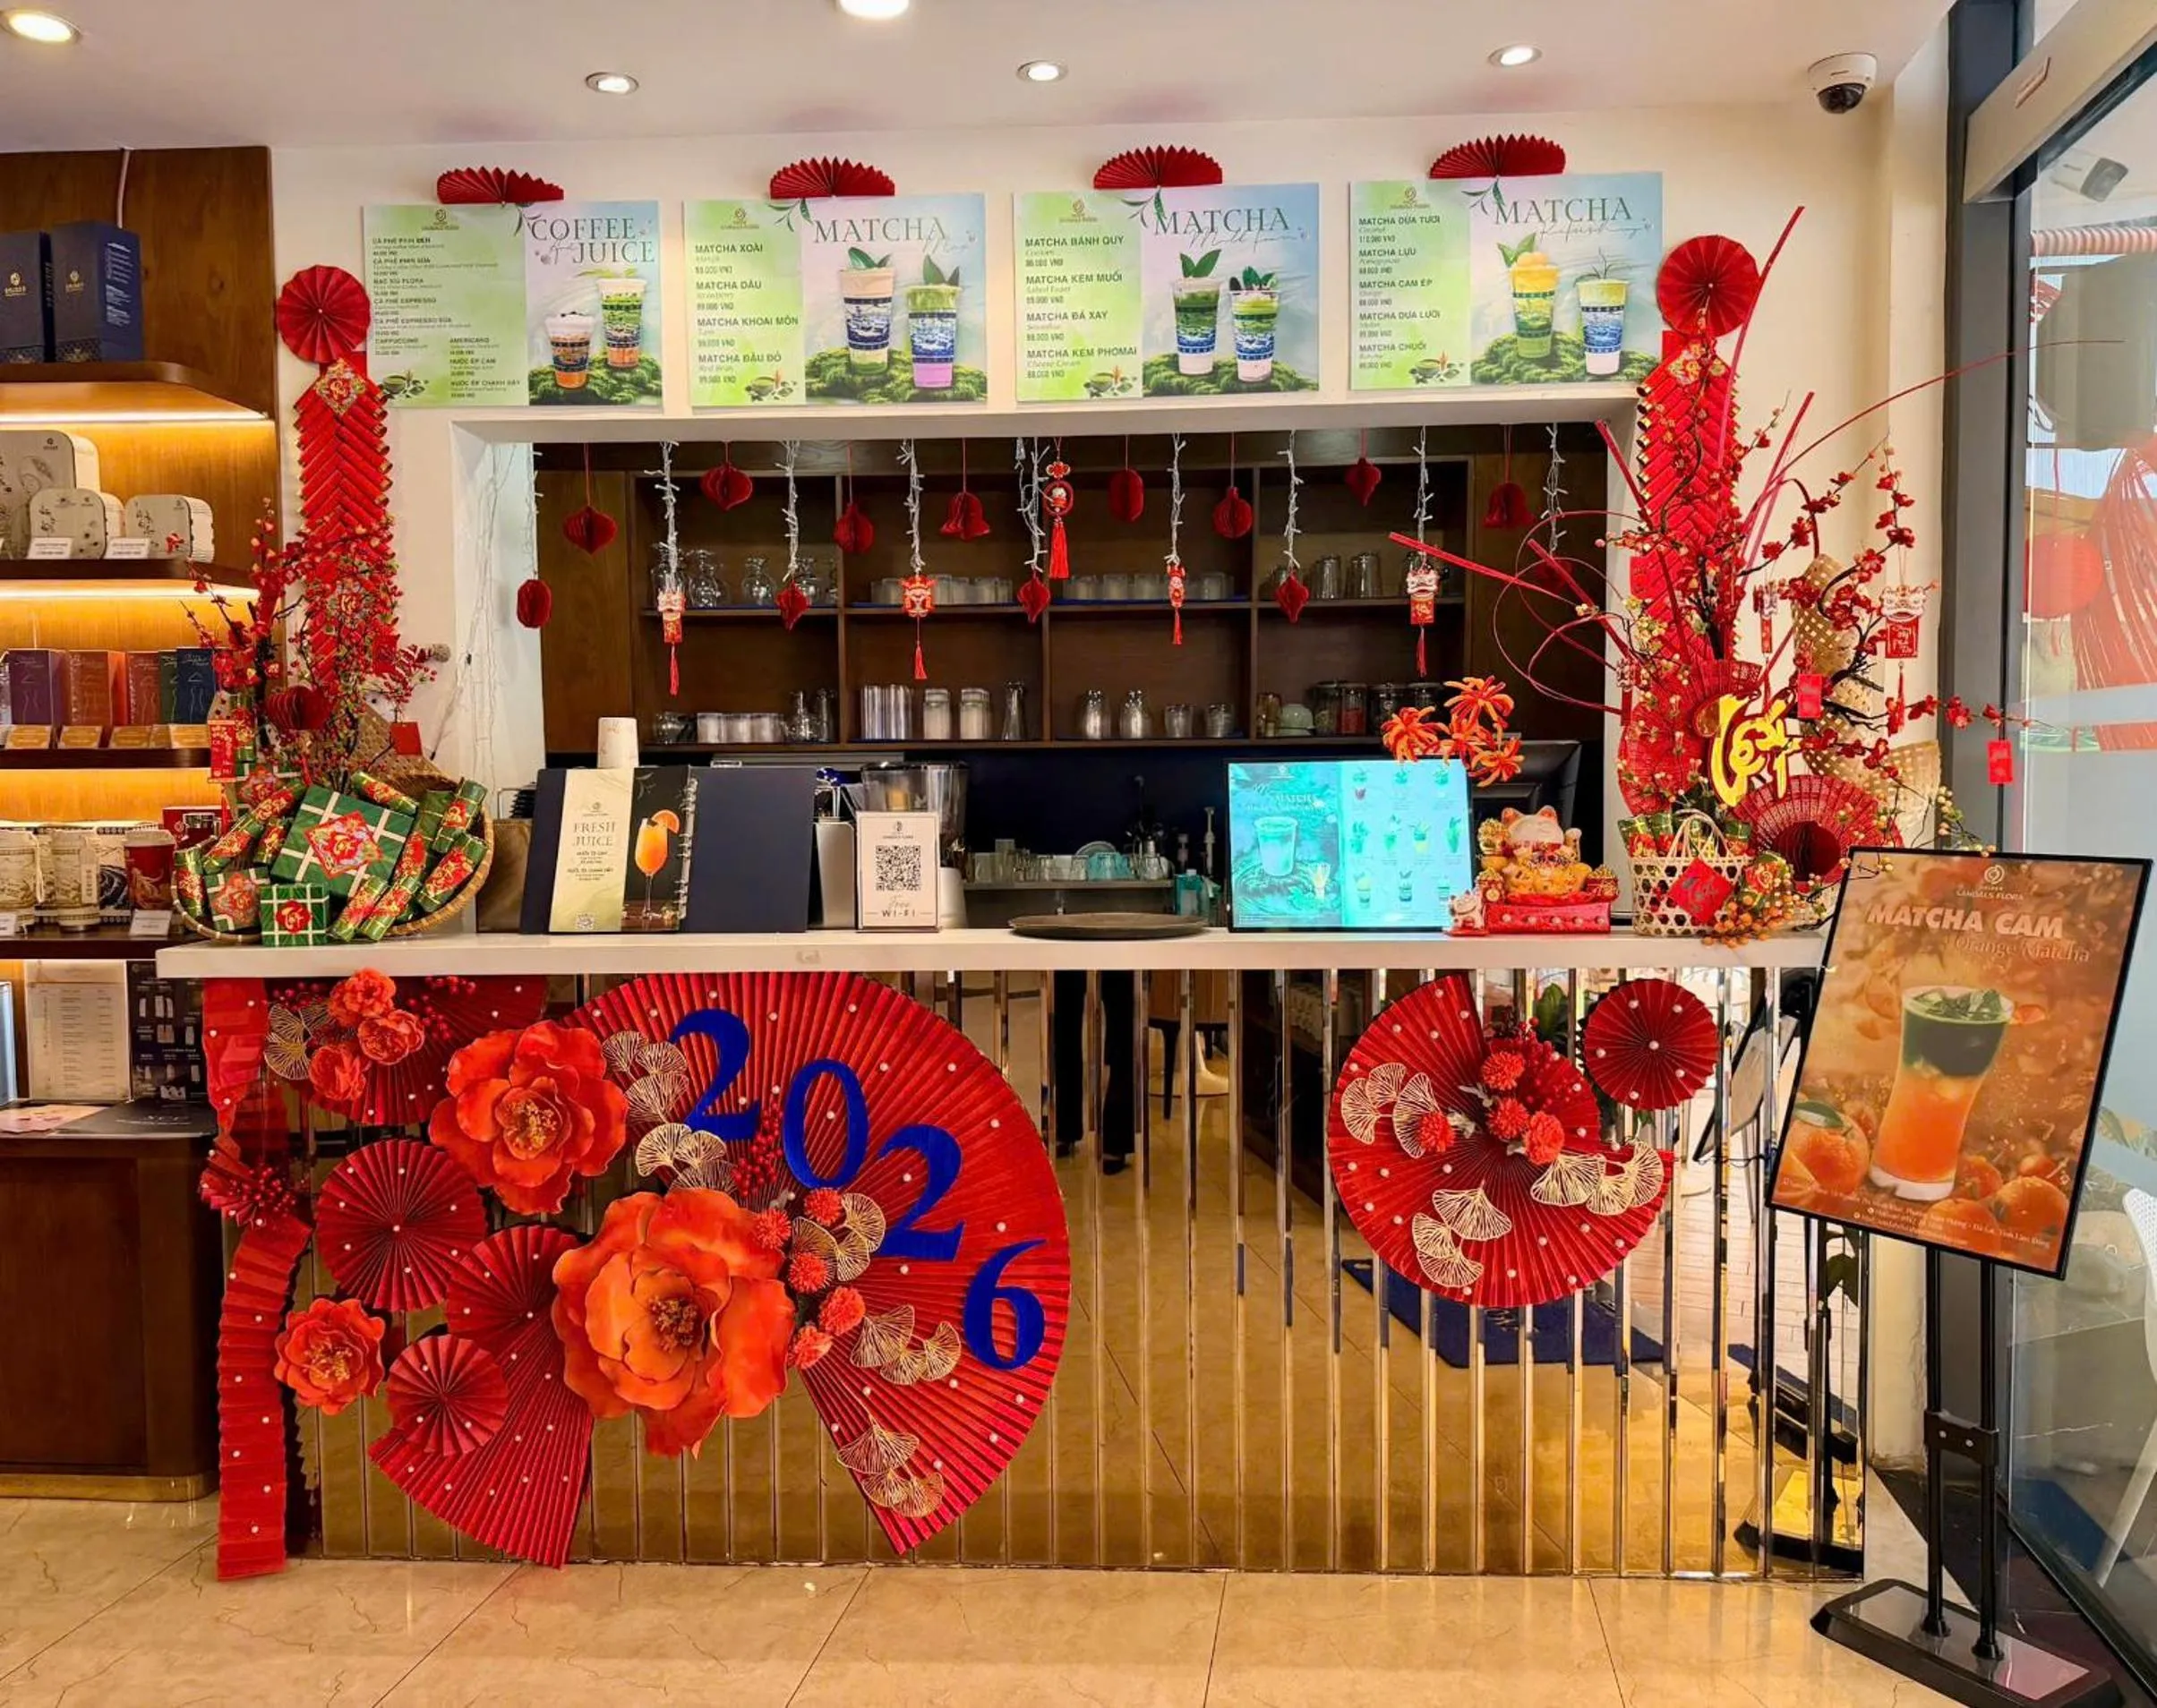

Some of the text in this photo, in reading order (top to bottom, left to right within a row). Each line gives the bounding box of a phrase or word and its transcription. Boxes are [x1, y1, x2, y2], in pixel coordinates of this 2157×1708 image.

[1495, 196, 1632, 225] MATCHA
[1154, 207, 1290, 235] MATCHA
[1358, 217, 1396, 226] MATCHA
[531, 218, 636, 241] COFFEE
[814, 216, 946, 243] MATCHA
[695, 242, 764, 253] MATCHA XOÀI
[1025, 237, 1067, 247] MATCHA
[572, 241, 655, 264] JUICE
[1358, 248, 1396, 257] MATCHA
[696, 280, 738, 290] MATCHA
[1026, 275, 1068, 285] MATCHA
[1071, 274, 1093, 283] KEM
[1358, 280, 1396, 289] MATCHA
[1398, 279, 1418, 288] CAM
[1026, 312, 1068, 321] MATCHA
[1088, 310, 1108, 320] XAY
[1358, 312, 1397, 320] MATCHA
[697, 318, 740, 327] MATCHA
[741, 317, 773, 326] KHOAI
[1027, 349, 1069, 358] MATCHA
[1072, 348, 1095, 358] KEM
[1358, 343, 1396, 352] MATCHA
[698, 354, 740, 363] MATCHA
[573, 821, 615, 833] FRESH
[571, 836, 613, 847] JUICE
[1867, 903, 2064, 939] MATCHA CAM
[1956, 935, 2091, 963] Orange Matcha
[667, 1007, 1048, 1371] 2026
